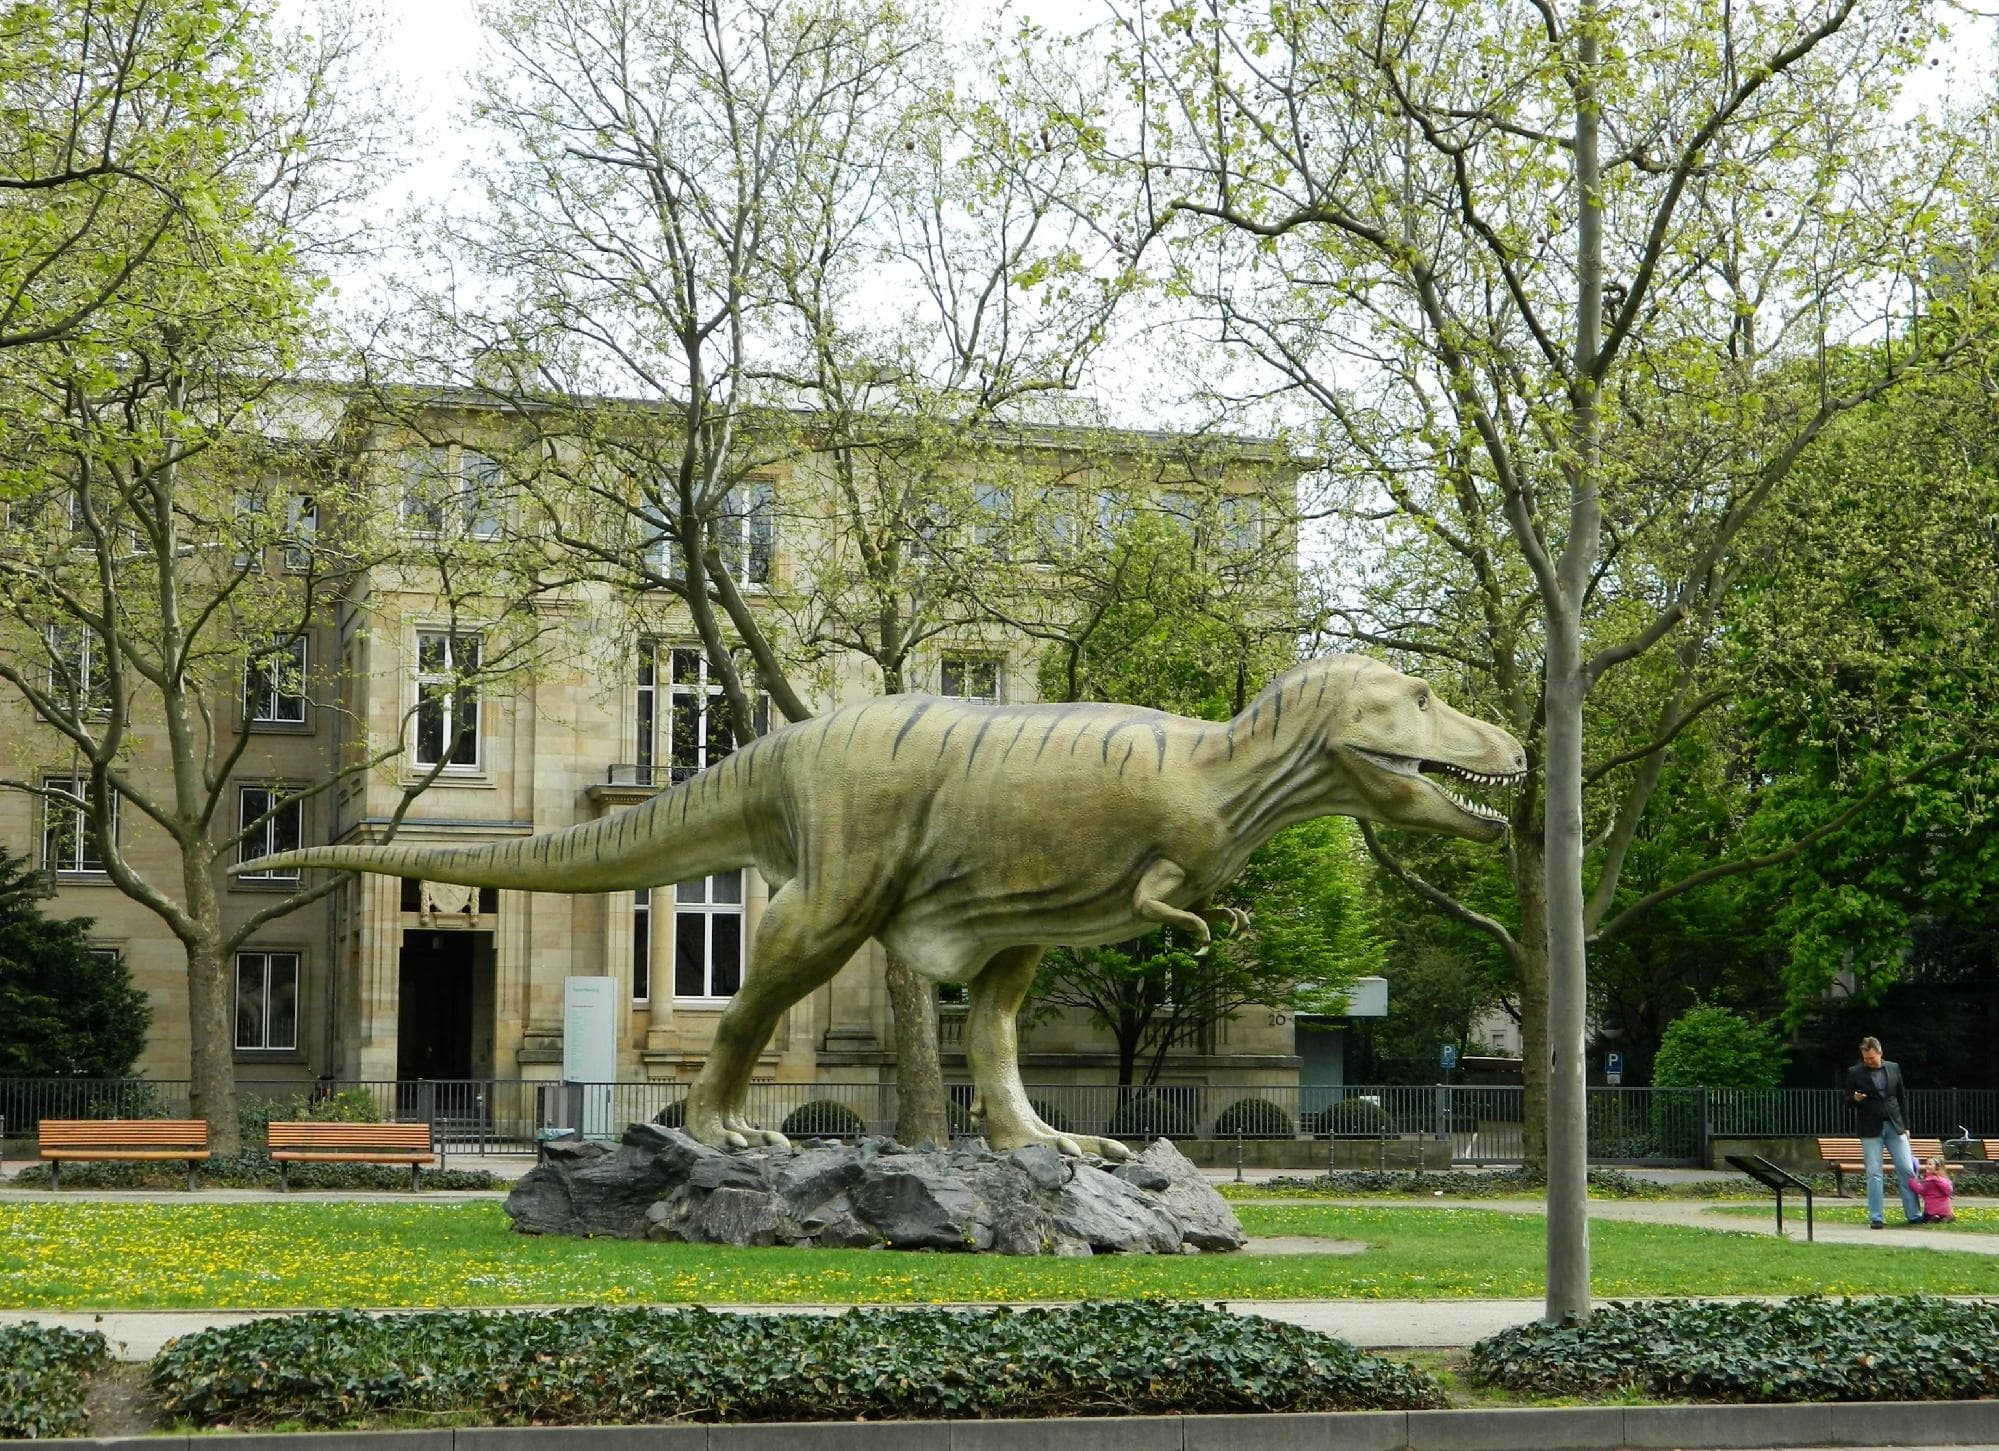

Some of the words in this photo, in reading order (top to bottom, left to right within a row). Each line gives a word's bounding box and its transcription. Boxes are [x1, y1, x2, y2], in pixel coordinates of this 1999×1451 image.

[1268, 1014, 1286, 1026] 20
[1444, 1045, 1452, 1058] P
[1609, 1053, 1619, 1067] P
